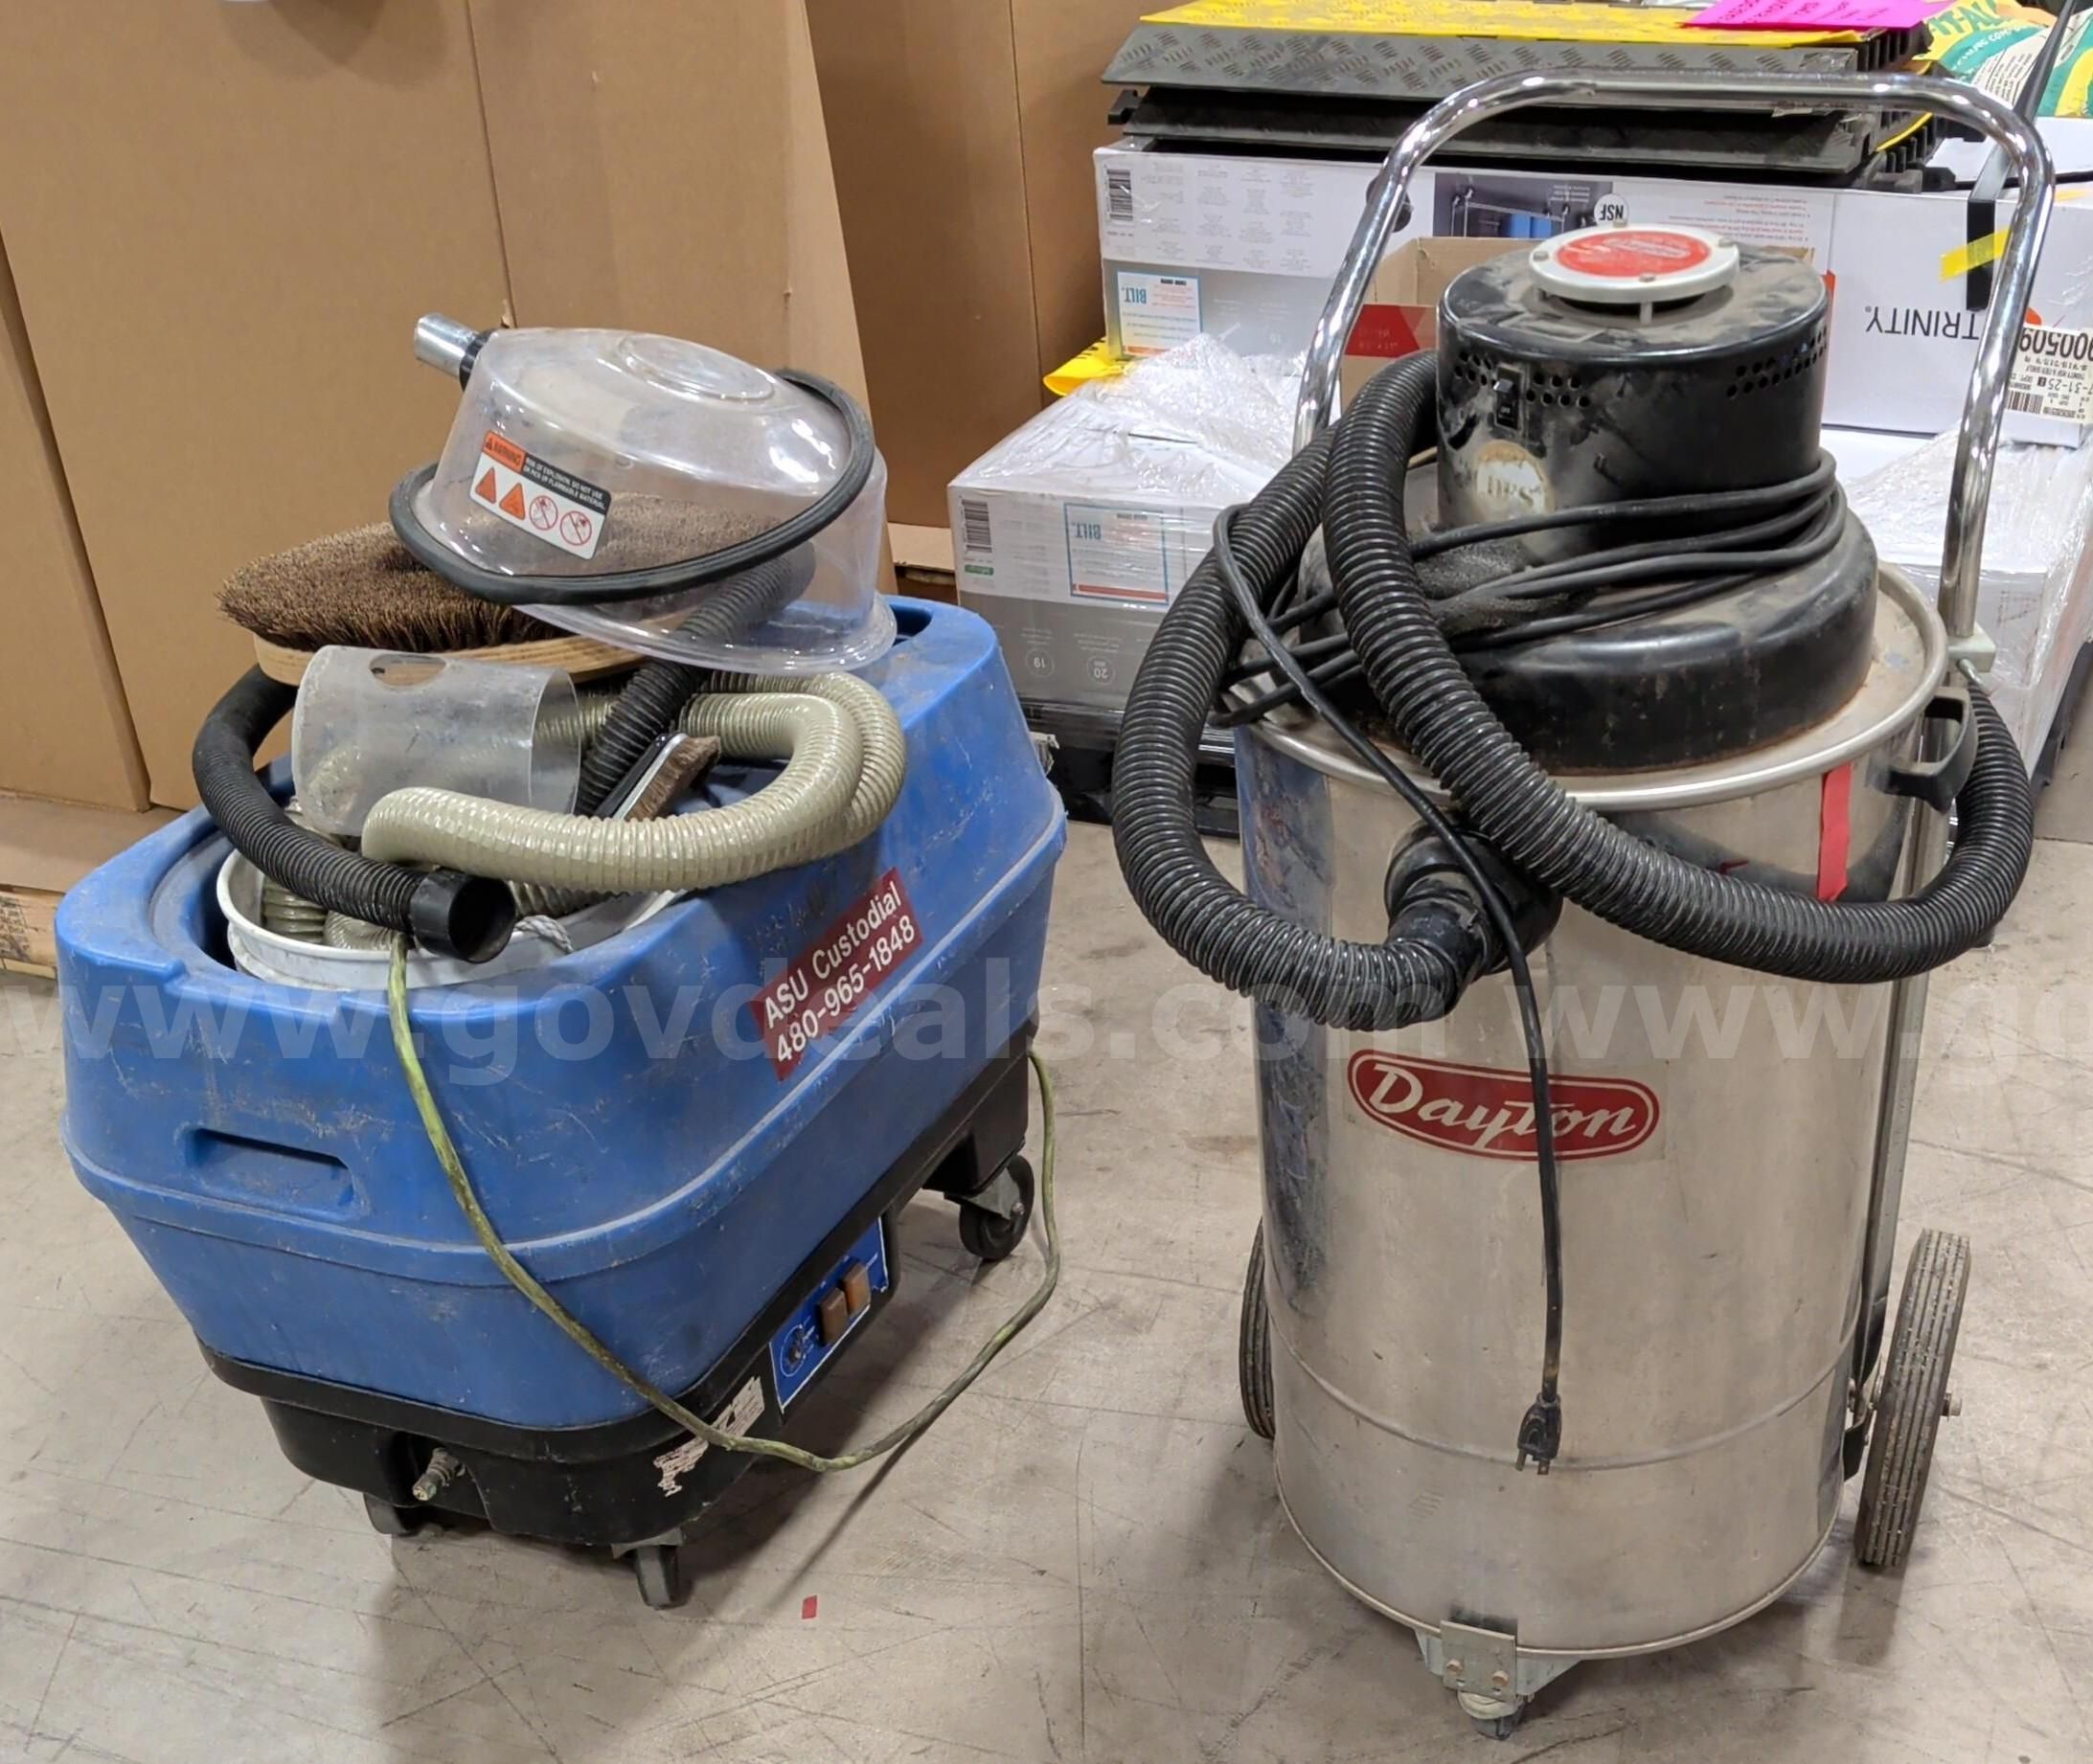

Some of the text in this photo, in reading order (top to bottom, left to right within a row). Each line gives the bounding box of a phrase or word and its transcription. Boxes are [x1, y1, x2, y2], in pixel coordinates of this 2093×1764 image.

[1599, 204, 1625, 221] NSF
[1865, 305, 1980, 341] TRINITY
[763, 880, 902, 1029] ASU Custodial
[777, 915, 915, 1063] 480-965-1848
[1368, 1063, 1636, 1150] Dayton
